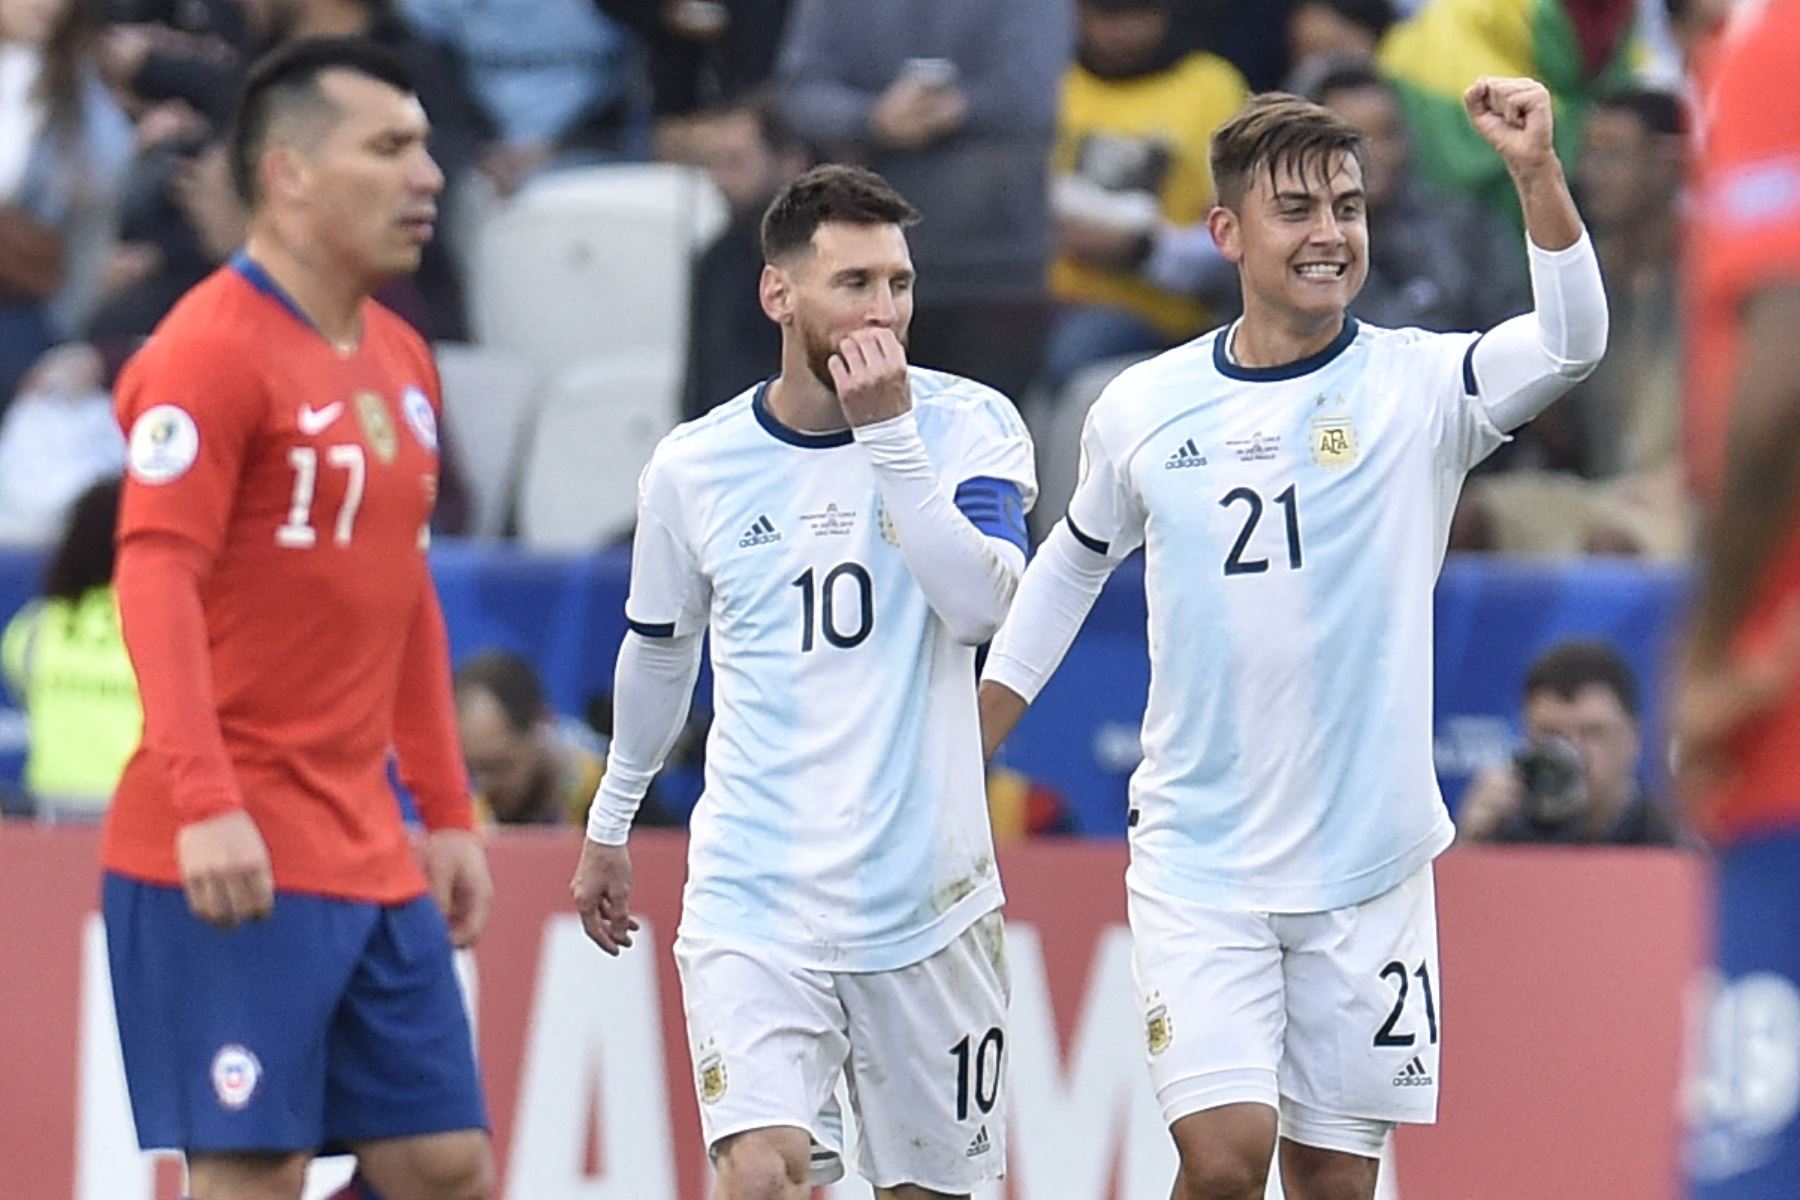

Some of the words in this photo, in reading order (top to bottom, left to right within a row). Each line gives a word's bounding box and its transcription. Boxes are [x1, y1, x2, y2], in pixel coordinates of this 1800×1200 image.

[274, 444, 366, 549] 17
[1165, 457, 1208, 470] adidas
[738, 532, 782, 549] adidas
[1218, 483, 1303, 576] 21
[791, 561, 874, 653] 10
[1373, 958, 1437, 1047] 21
[948, 1026, 1004, 1121] 10
